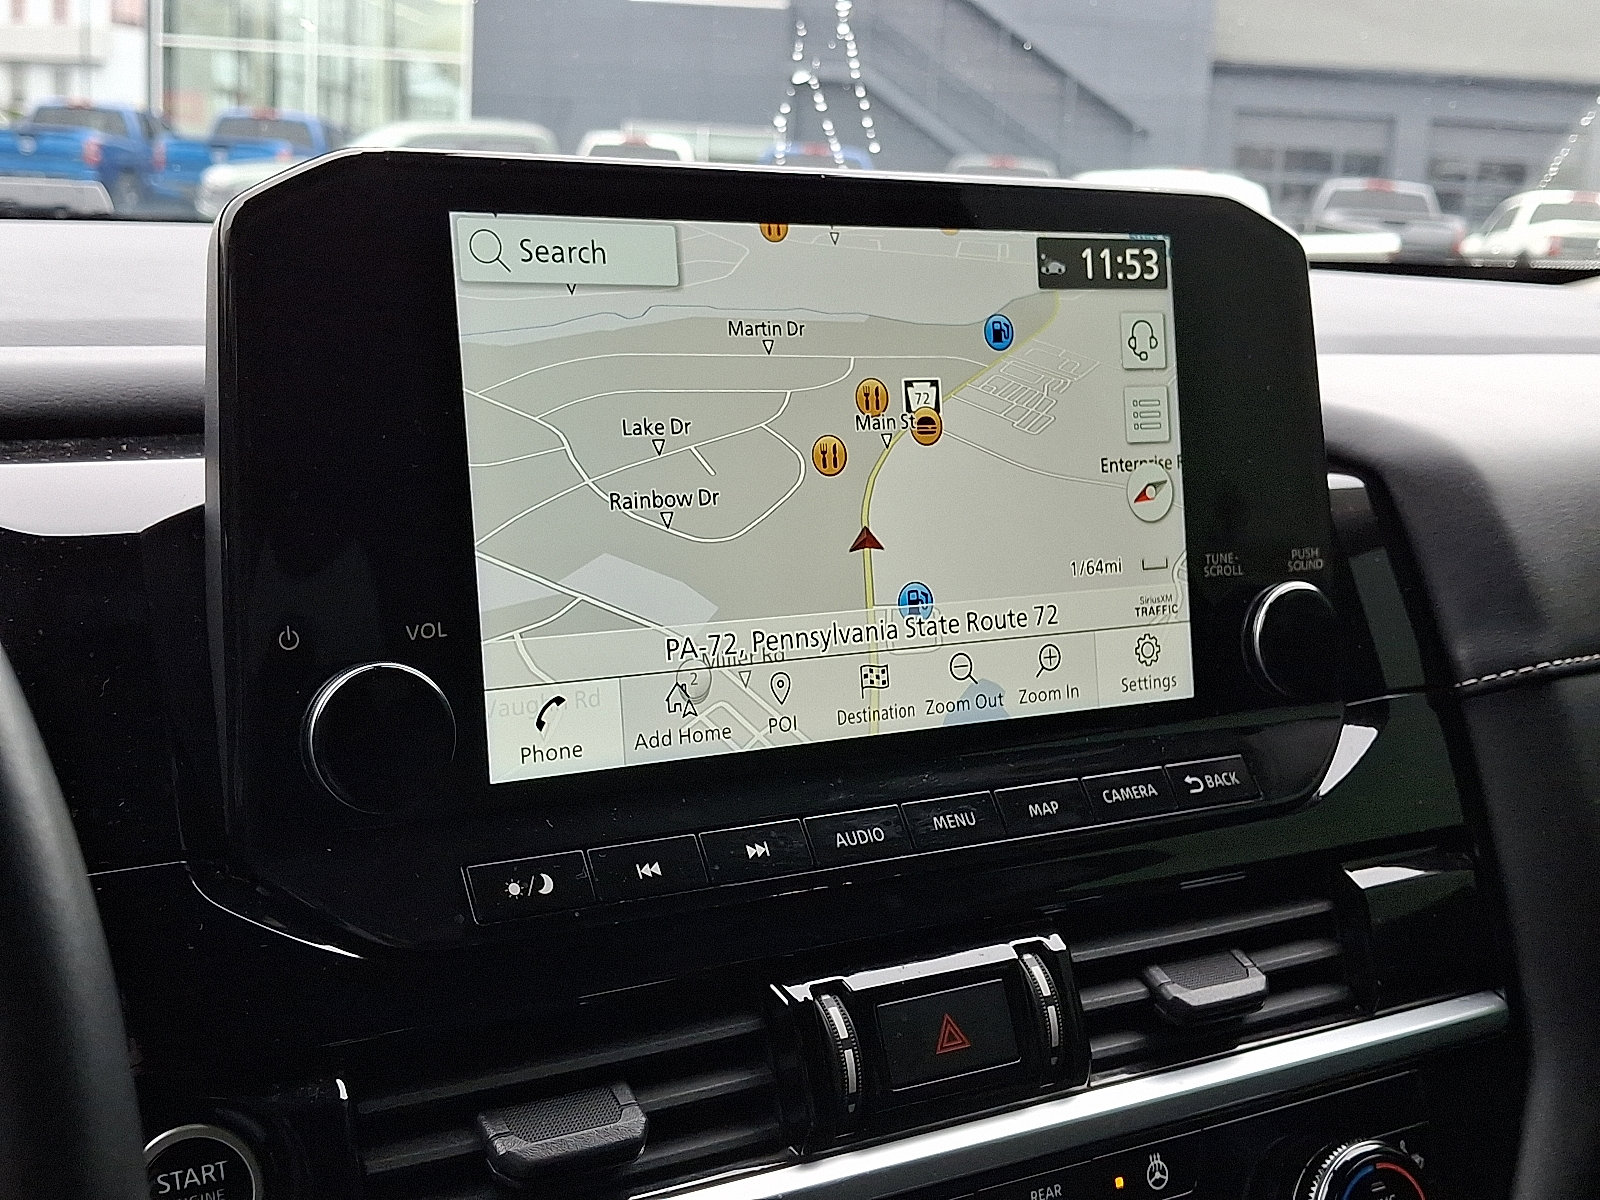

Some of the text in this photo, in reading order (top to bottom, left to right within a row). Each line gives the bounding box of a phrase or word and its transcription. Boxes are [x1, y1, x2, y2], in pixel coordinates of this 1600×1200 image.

[519, 238, 607, 265] Search
[1080, 248, 1160, 281] 11:53
[728, 320, 805, 337] Martin Dr
[914, 392, 930, 405] 72
[622, 418, 692, 436] Lake Dr
[855, 413, 917, 431] Main St
[1100, 454, 1173, 474] Enterise
[609, 489, 720, 511] Rainbow Dr
[1291, 547, 1320, 560] PUSH
[1070, 557, 1123, 577] 1/64mi
[1203, 564, 1244, 578] SCROLL
[1287, 558, 1324, 573] SOUND
[1139, 593, 1173, 605] SiriusXM
[1134, 603, 1179, 617] TRAFFIC
[405, 621, 448, 641] VOL
[665, 605, 1059, 661] PA-72, Pennsylvania State Route 72
[690, 672, 698, 686] 2
[1120, 673, 1178, 693] Settings
[575, 687, 601, 709] Rd
[925, 692, 1004, 716] Zoom Out
[1018, 684, 1080, 705] Zoom In
[836, 701, 916, 726] Destination
[768, 715, 798, 734] POI
[634, 724, 732, 750] Add Home
[520, 742, 583, 765] Phone
[1205, 770, 1240, 790] BACK
[1102, 782, 1158, 805] CAMERA
[1028, 801, 1059, 818] MAP
[932, 810, 976, 831] MENU
[835, 826, 885, 849] AUDIO
[156, 1160, 228, 1194] START
[1030, 1183, 1063, 1200] REAR
